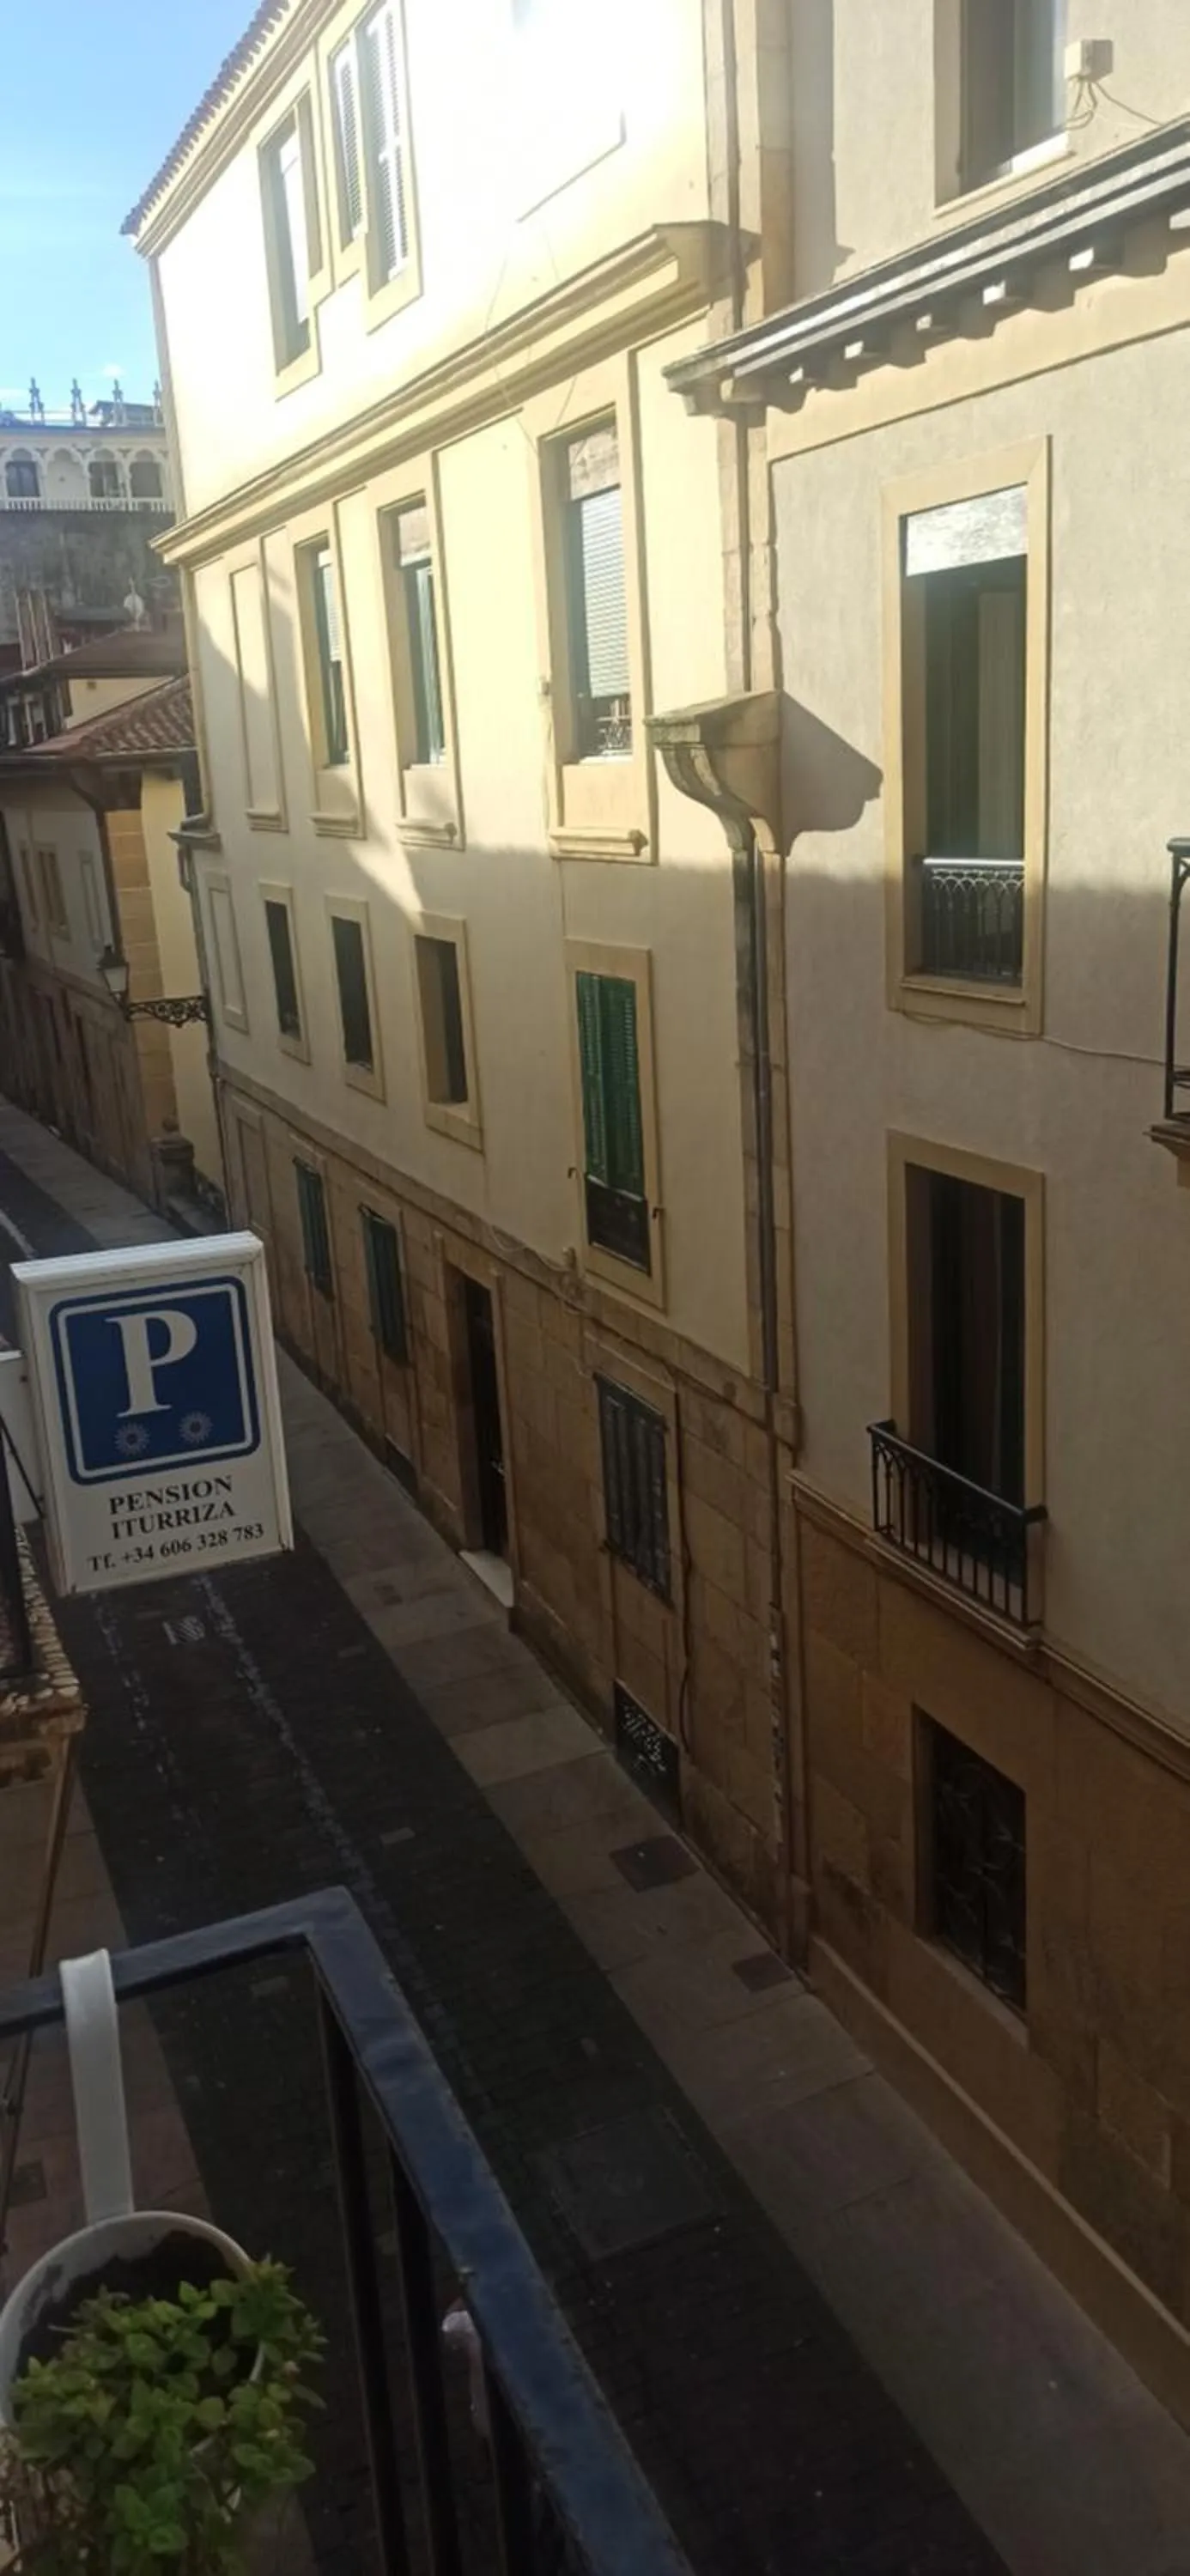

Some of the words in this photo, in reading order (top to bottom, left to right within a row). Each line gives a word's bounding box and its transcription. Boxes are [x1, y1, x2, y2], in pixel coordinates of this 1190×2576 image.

[105, 1309, 197, 1418] P
[109, 1474, 233, 1515] PENSION
[111, 1501, 236, 1540] ITURRIZA
[122, 1545, 154, 1563] +34
[160, 1538, 192, 1558] 606
[197, 1530, 228, 1550] 328
[233, 1523, 264, 1541] 783
